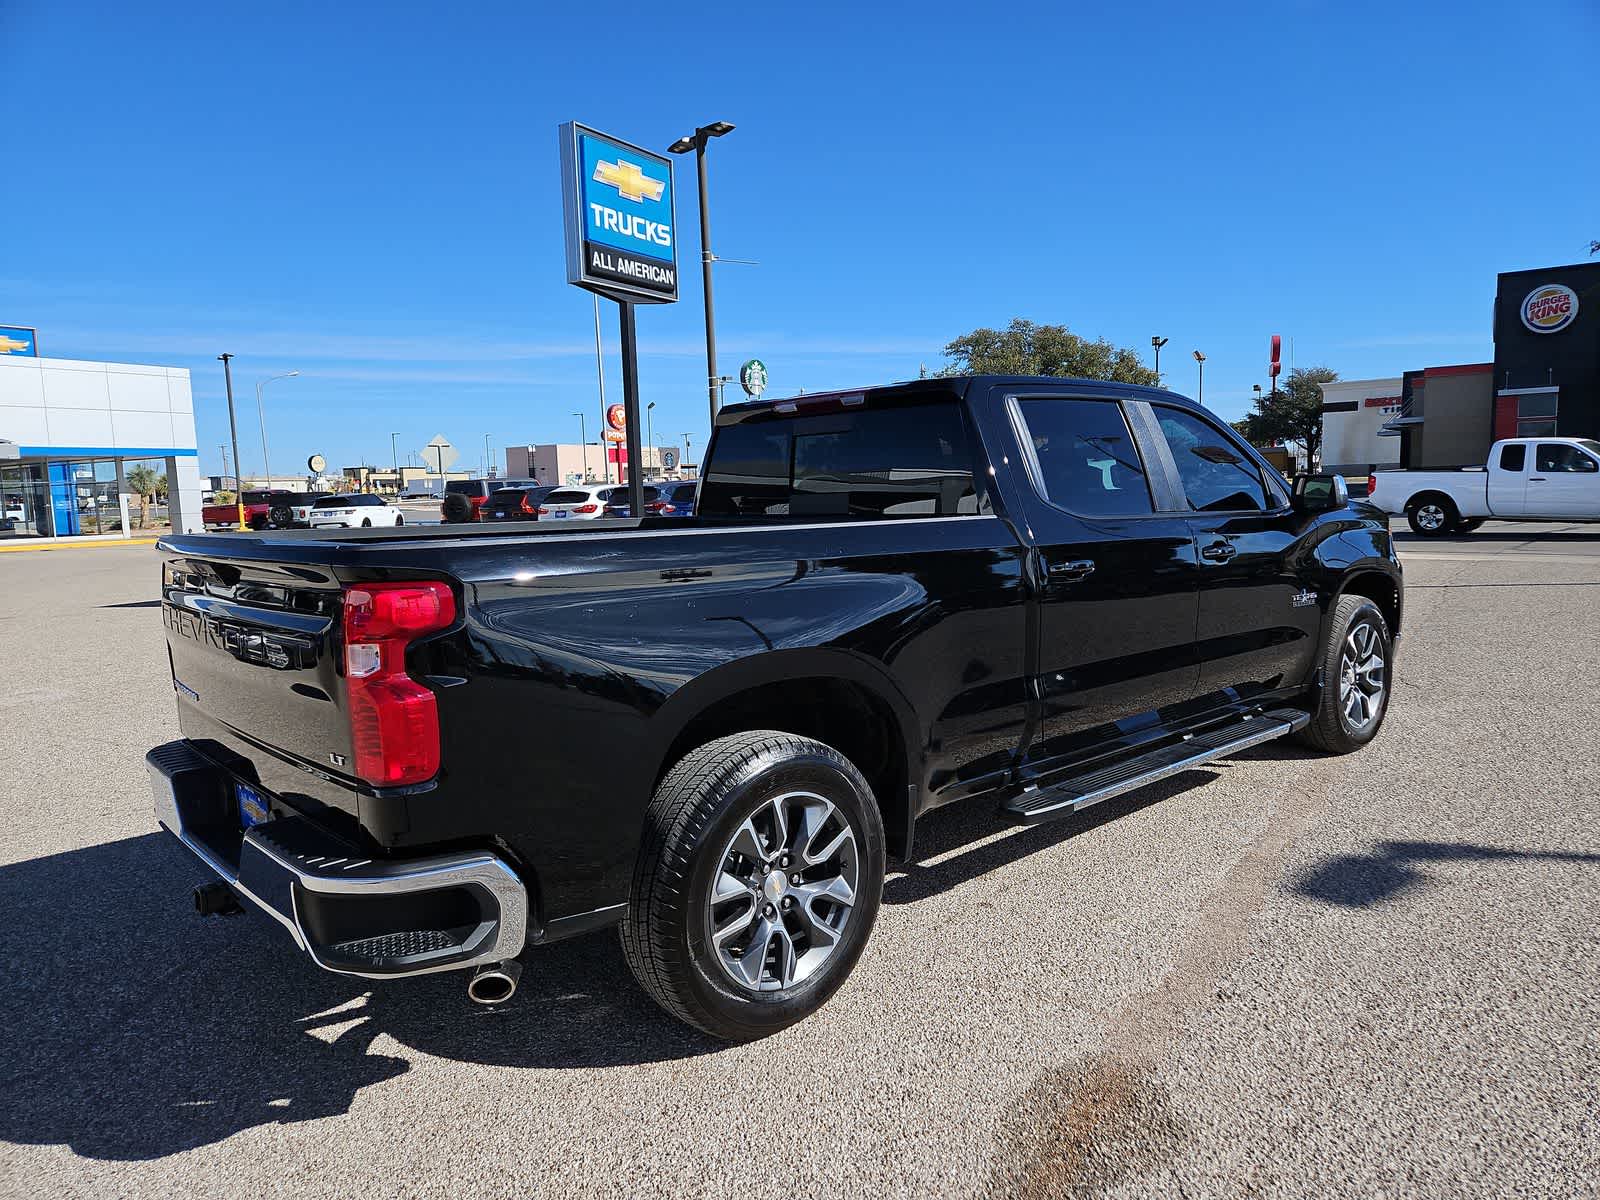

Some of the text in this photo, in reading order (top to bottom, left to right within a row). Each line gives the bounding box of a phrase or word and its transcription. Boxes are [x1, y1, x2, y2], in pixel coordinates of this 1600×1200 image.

[590, 202, 671, 247] TRUCKS
[592, 251, 674, 285] ALL AMERICAN
[1529, 294, 1570, 311] BURGER
[1529, 302, 1571, 321] KING
[329, 753, 345, 766] LT
